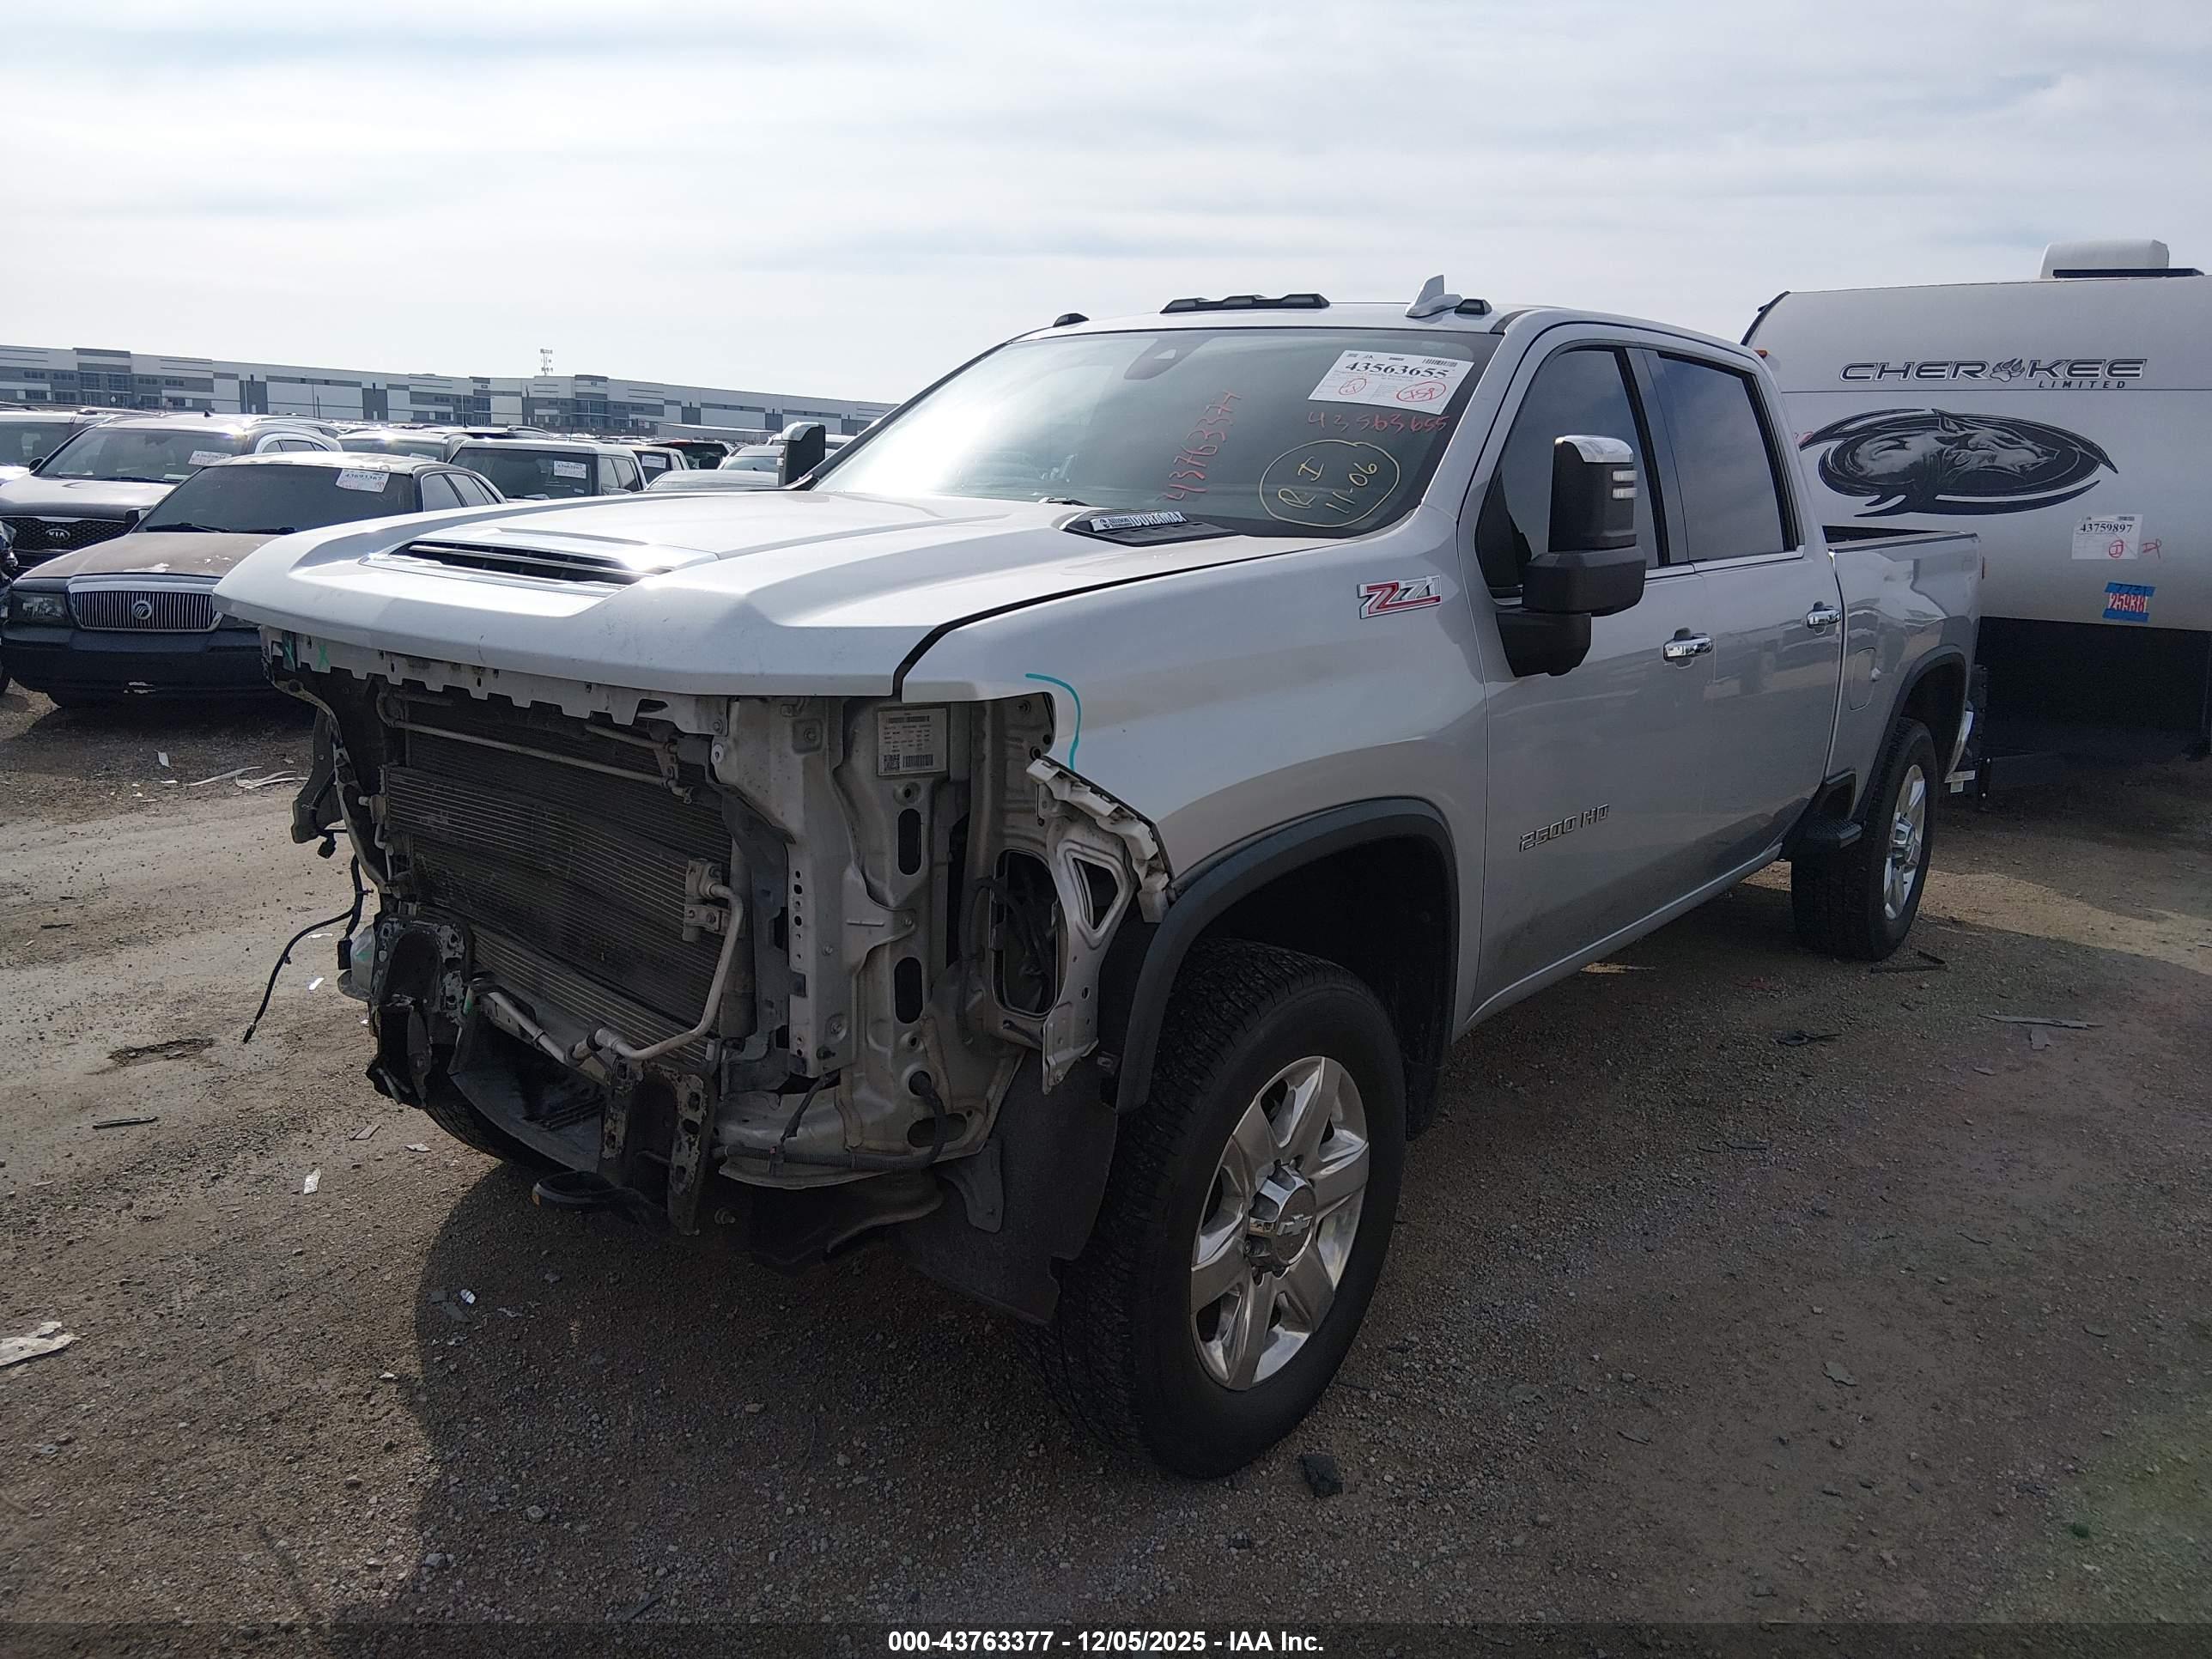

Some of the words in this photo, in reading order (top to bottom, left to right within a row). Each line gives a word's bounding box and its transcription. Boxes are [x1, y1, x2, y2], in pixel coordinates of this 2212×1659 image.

[1345, 361, 1449, 379] 43563655
[2039, 380, 2127, 389] LIMITED
[1308, 411, 1449, 434] 43563655
[1131, 510, 1188, 526] DURAMAX
[48, 531, 66, 540] KIA
[2081, 523, 2134, 533] 43759897
[1358, 575, 1443, 619] Z71
[1519, 816, 1577, 852] 2500
[1580, 803, 1610, 828] HD
